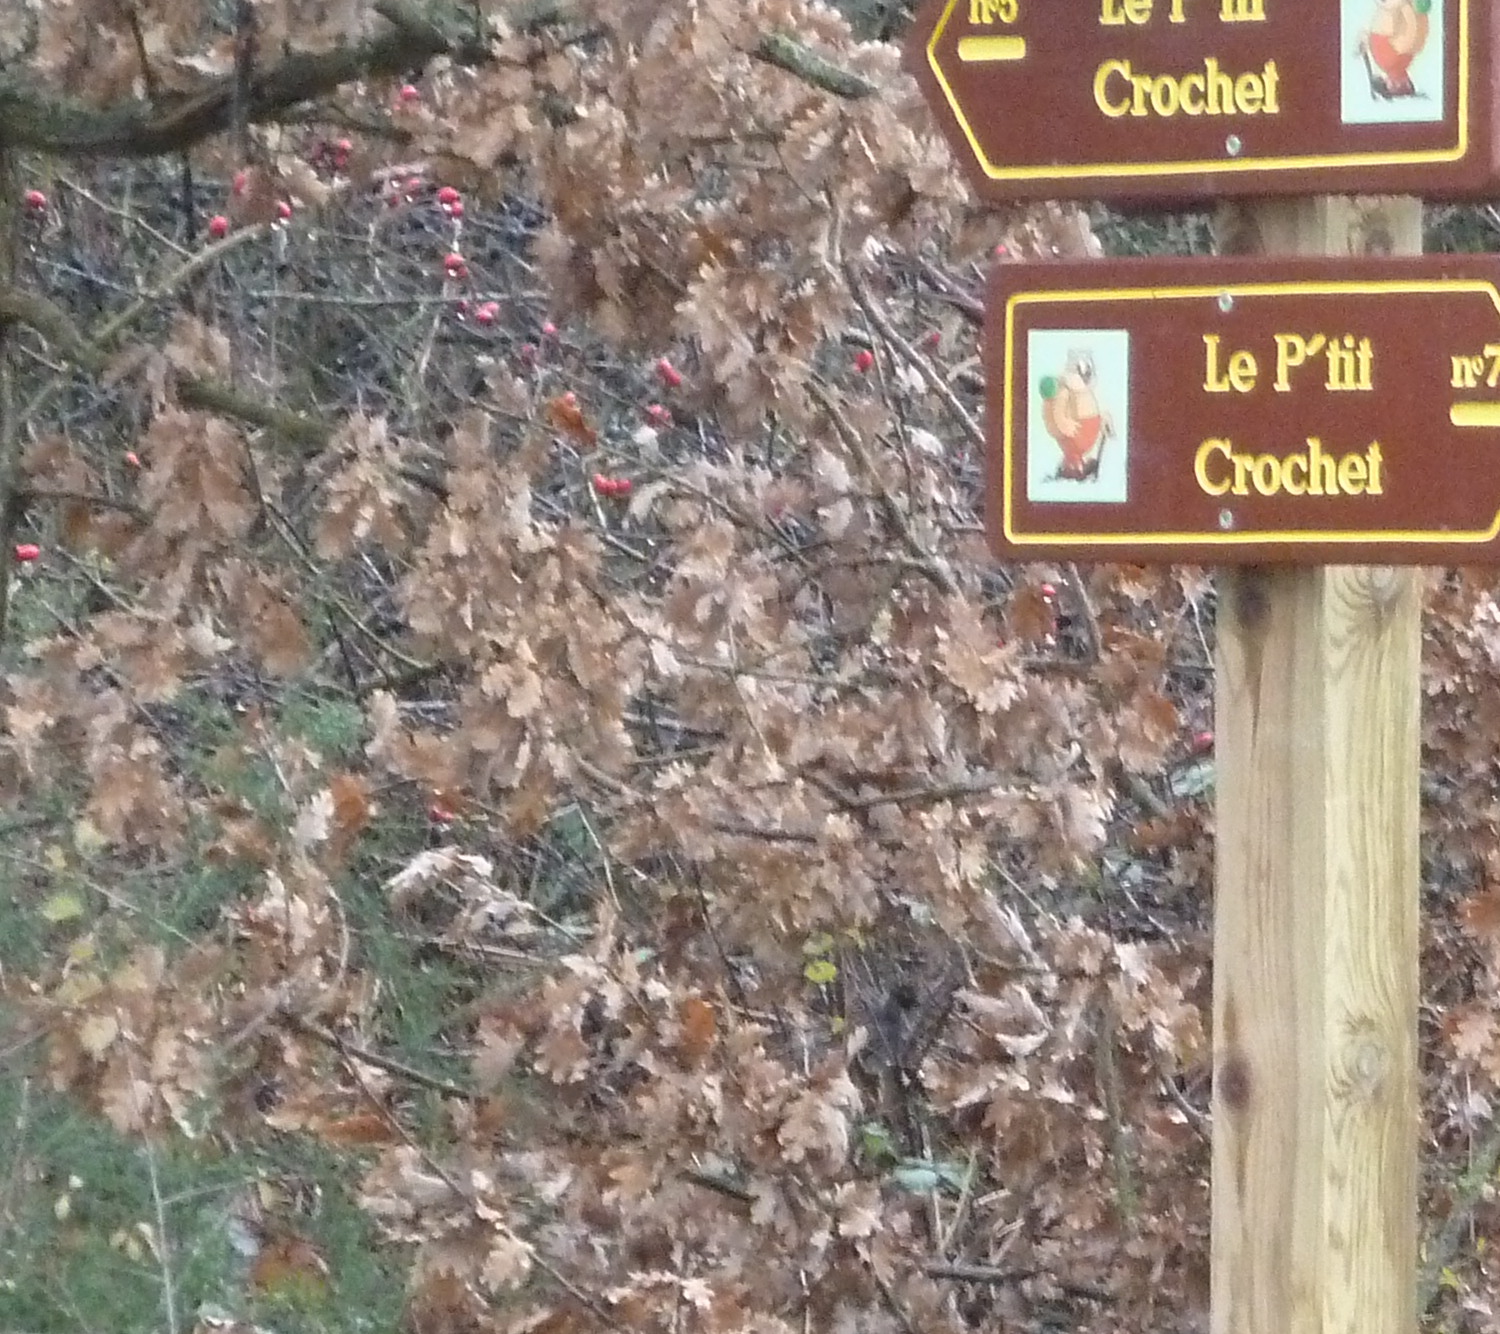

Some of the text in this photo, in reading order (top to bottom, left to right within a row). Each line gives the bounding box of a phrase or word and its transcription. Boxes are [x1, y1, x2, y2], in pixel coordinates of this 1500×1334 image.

[1092, 56, 1280, 118] Crochet
[1202, 333, 1258, 393] Le
[1193, 435, 1384, 497] Crochet
